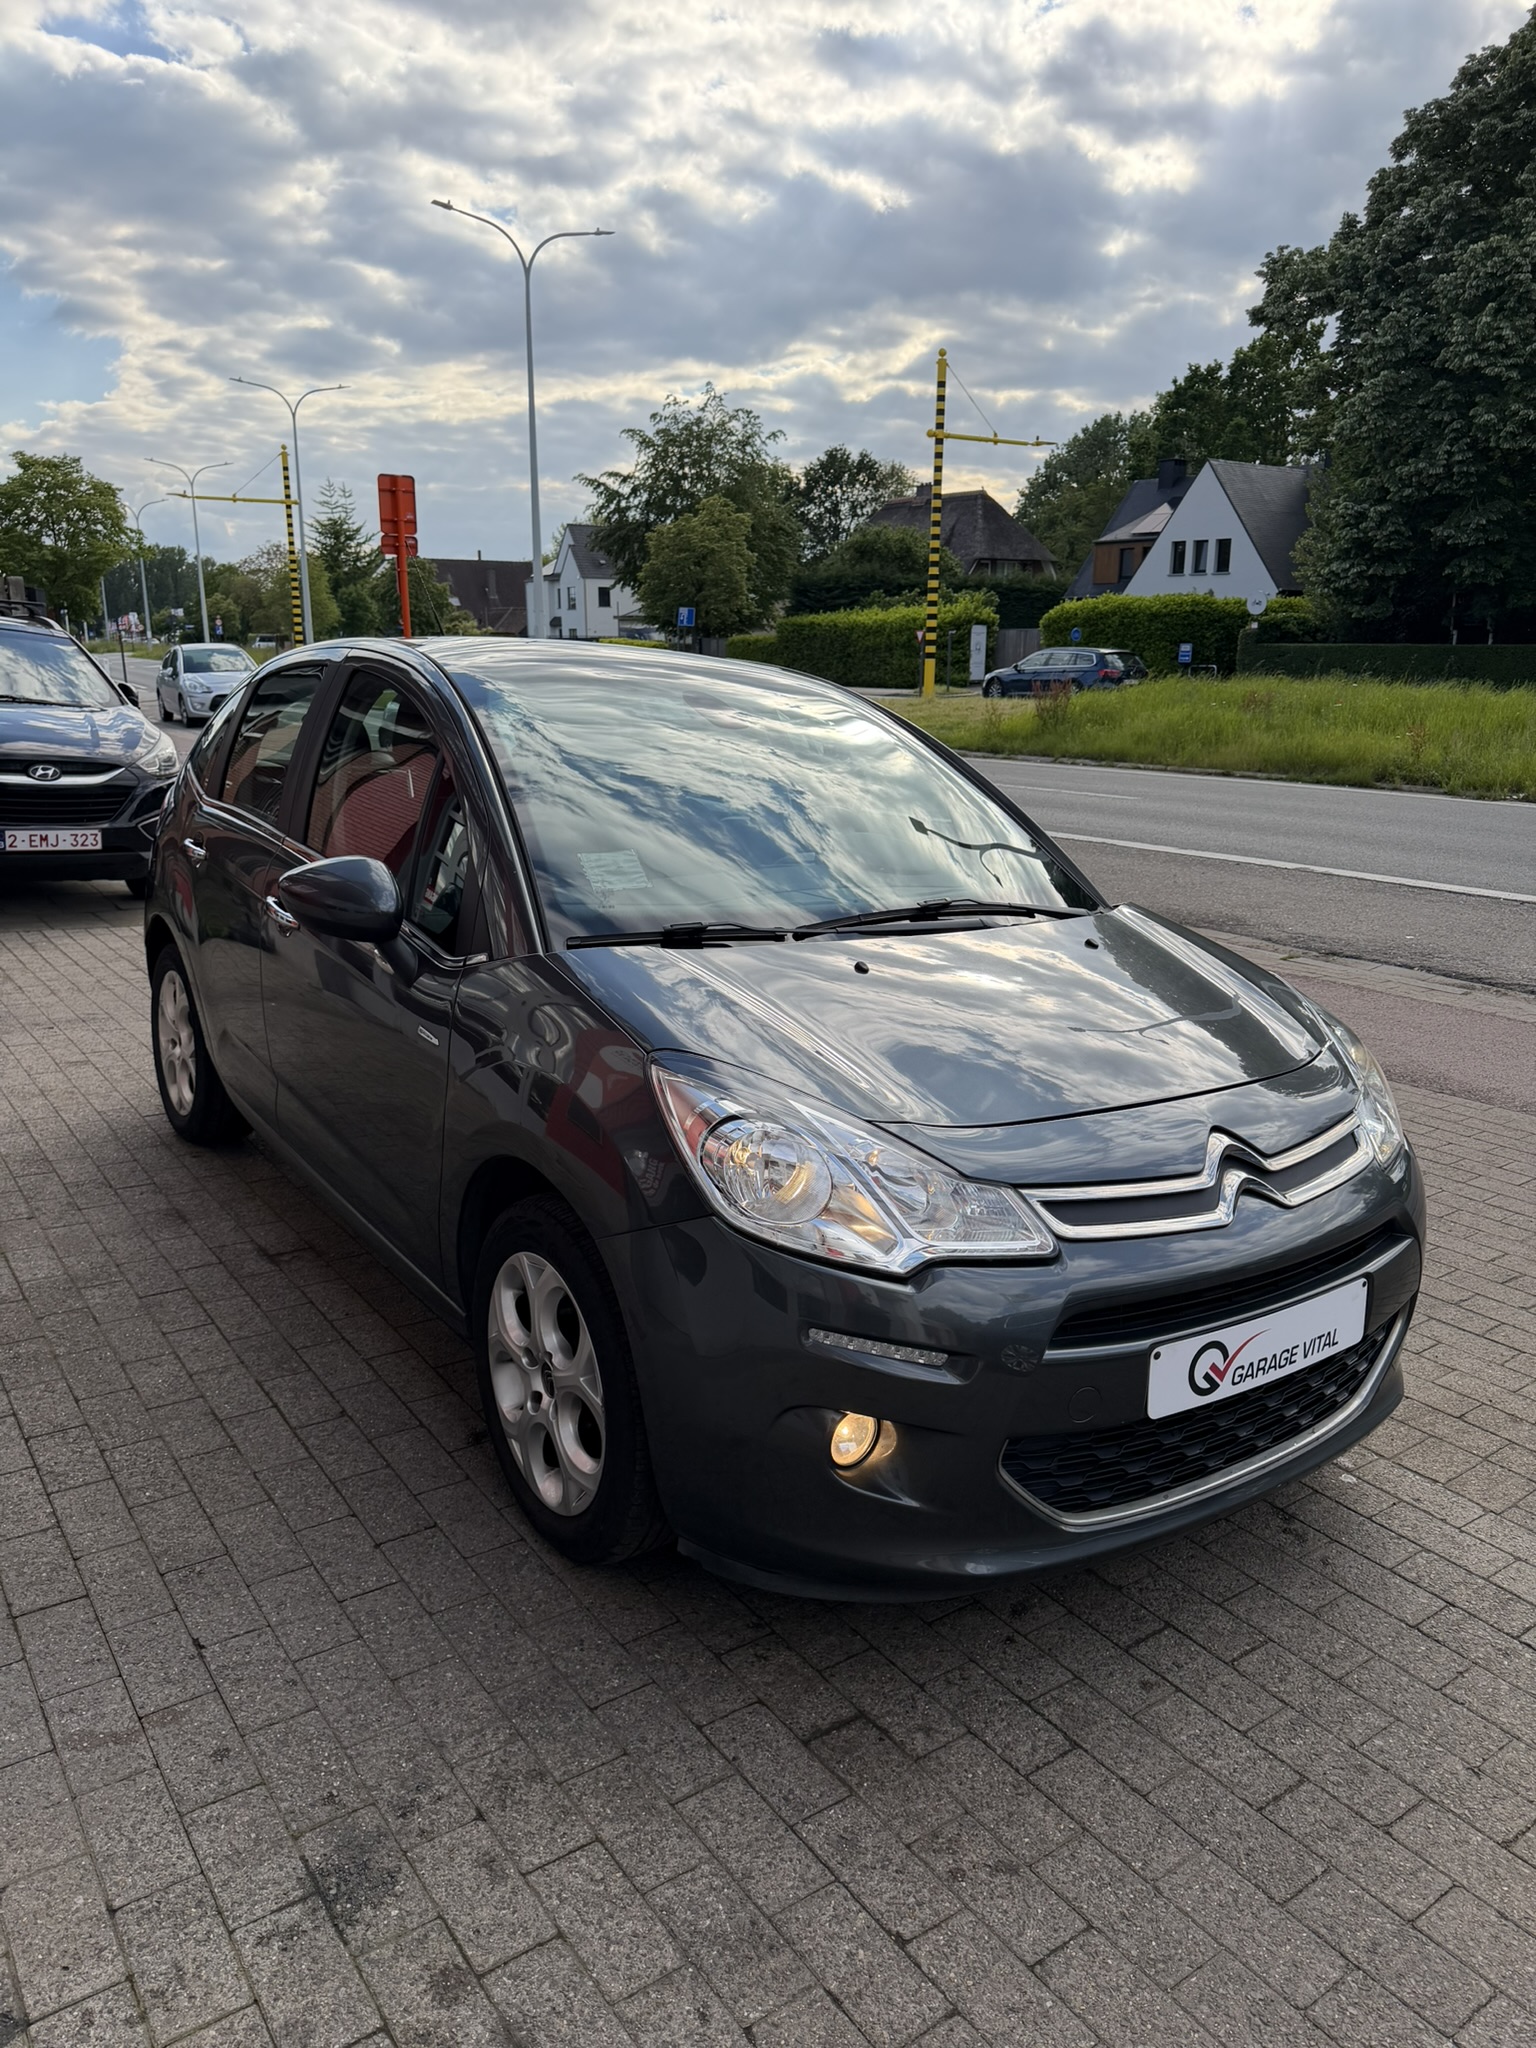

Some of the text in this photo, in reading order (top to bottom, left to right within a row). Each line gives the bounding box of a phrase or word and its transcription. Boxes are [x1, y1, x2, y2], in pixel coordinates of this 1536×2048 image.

[8, 833, 99, 848] 2-EMJ-323
[1231, 1328, 1339, 1386] GARAGE VITAL
